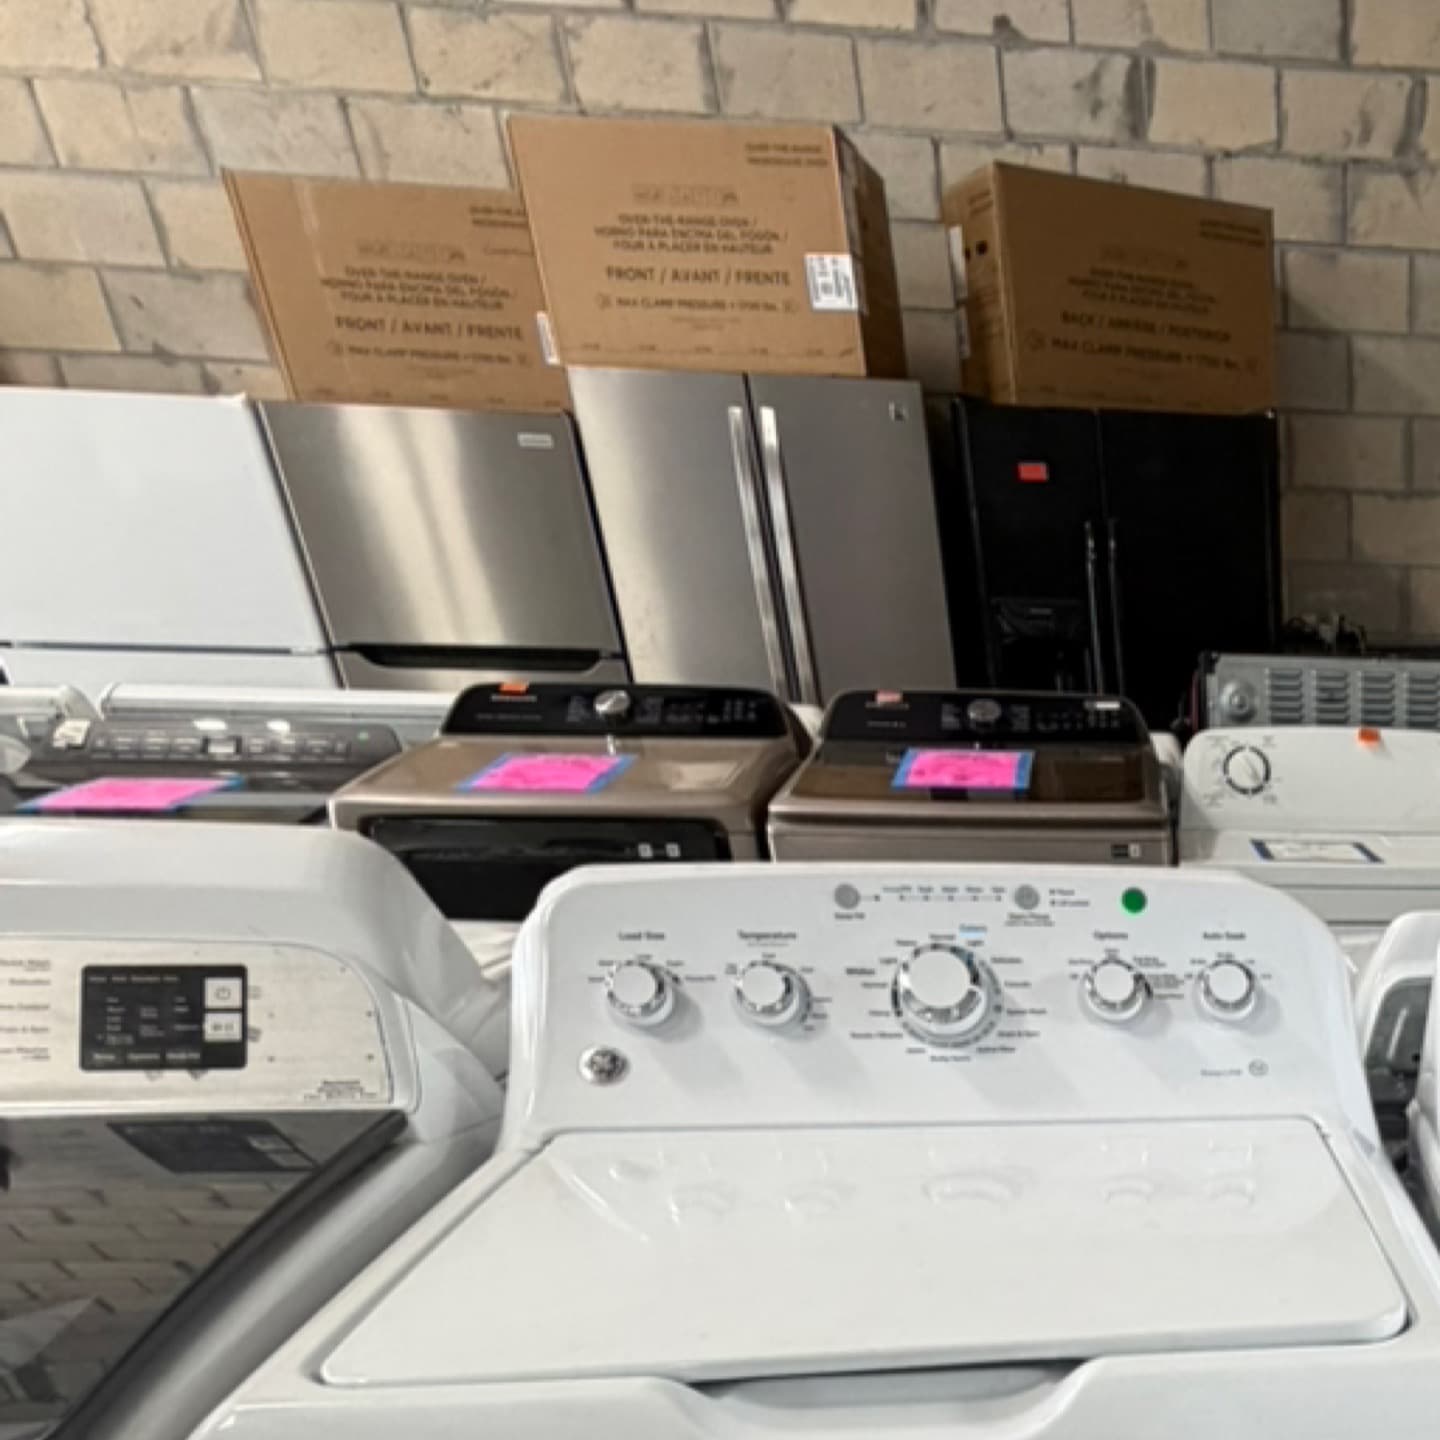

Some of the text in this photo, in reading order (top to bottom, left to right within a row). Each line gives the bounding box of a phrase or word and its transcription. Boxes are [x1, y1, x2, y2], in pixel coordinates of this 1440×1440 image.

[605, 265, 656, 283] FRONT
[670, 267, 721, 284] AVANT
[735, 269, 791, 287] FRENTE
[334, 315, 385, 334] FRONT
[402, 319, 452, 337] AVANT
[466, 322, 523, 341] FRENTE
[738, 928, 797, 942] Temperature
